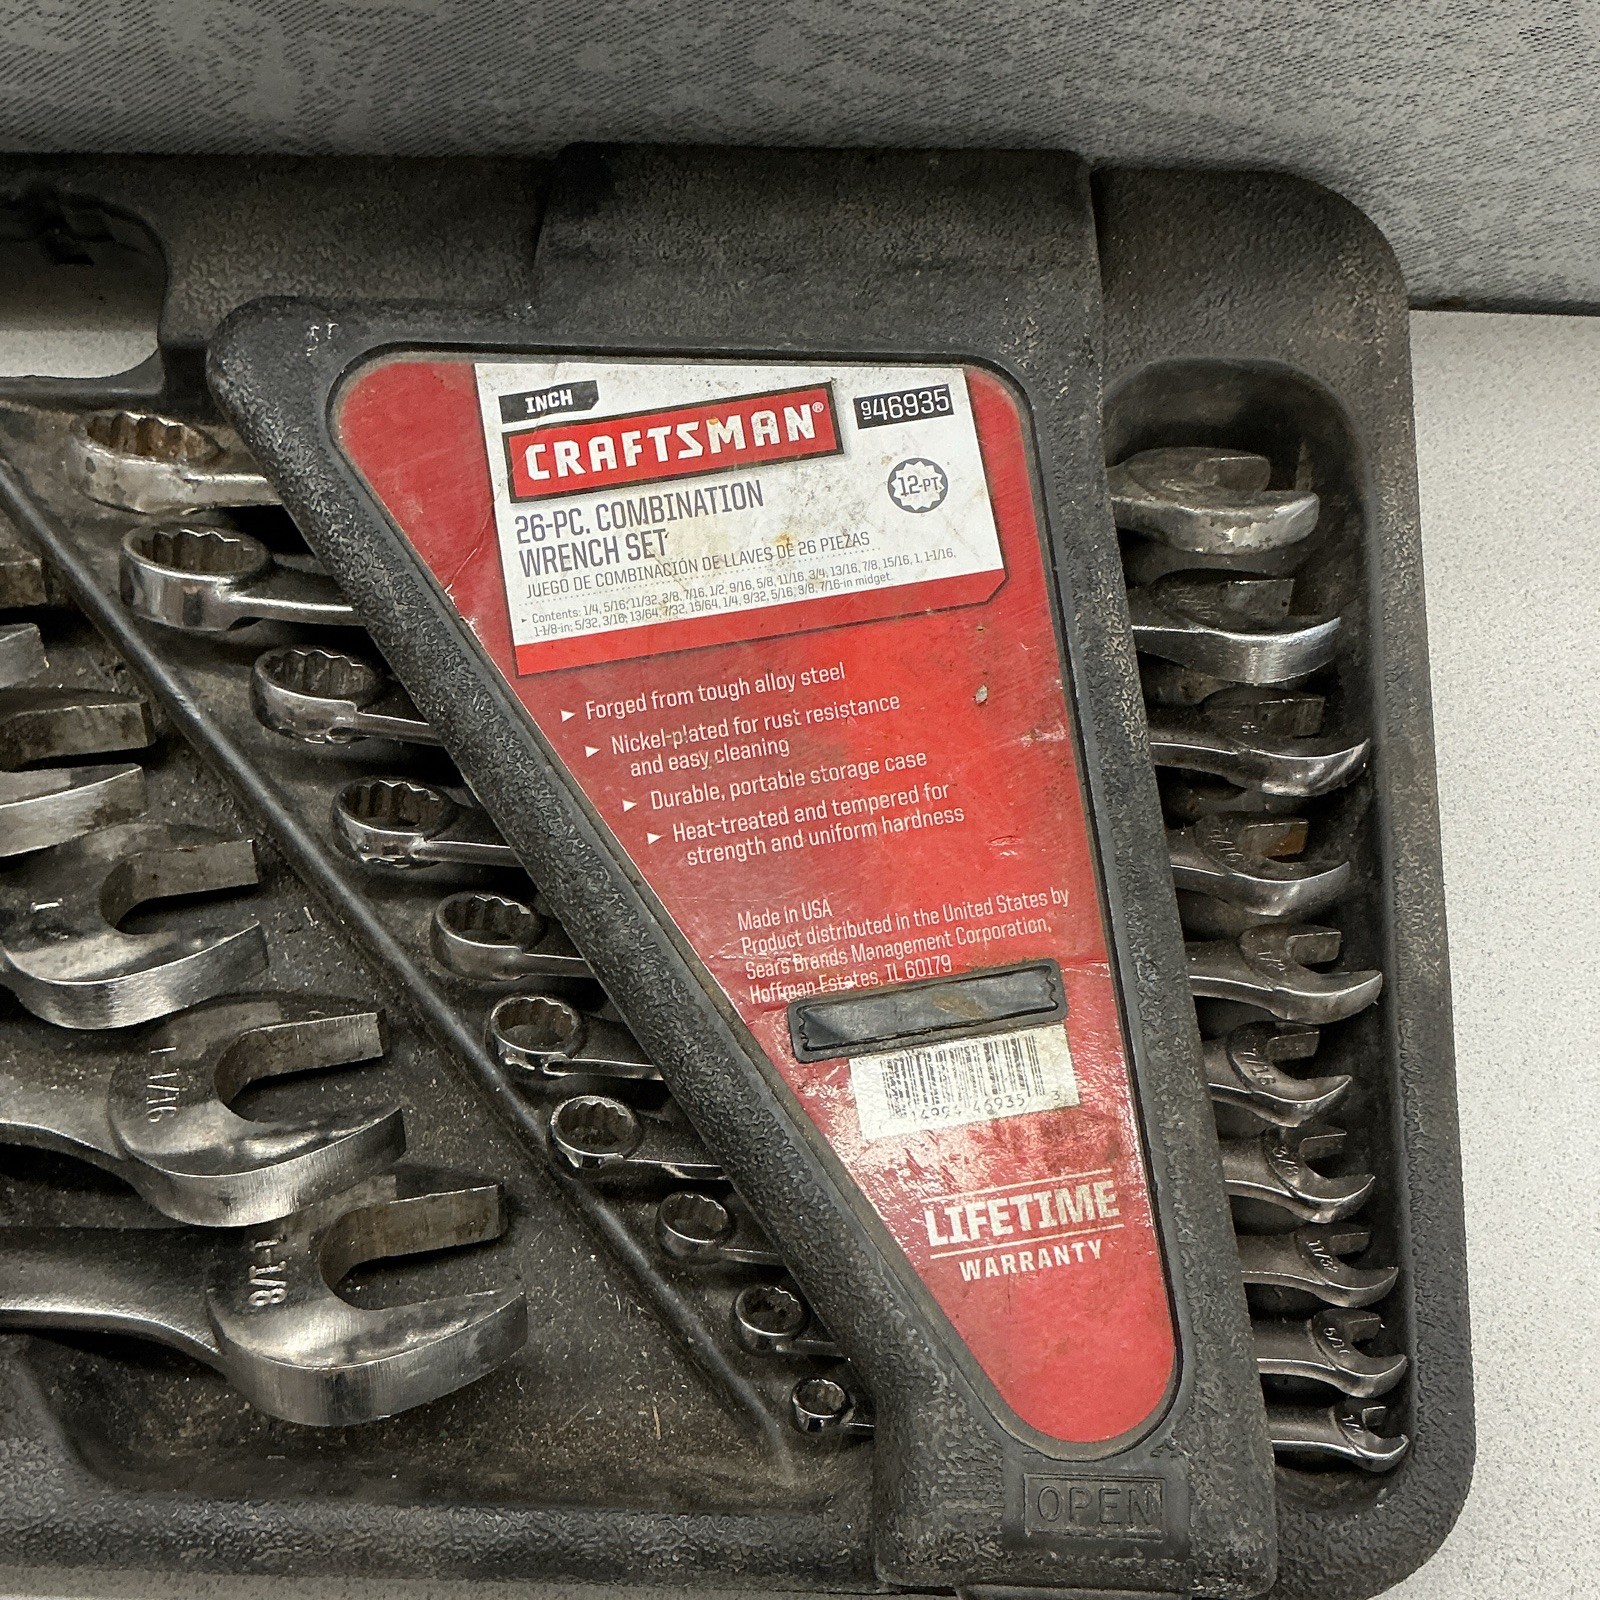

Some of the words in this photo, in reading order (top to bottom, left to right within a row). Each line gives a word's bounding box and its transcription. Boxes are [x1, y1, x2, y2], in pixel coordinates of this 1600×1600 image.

[524, 388, 574, 414] INCH
[514, 507, 591, 544] 26-PC.
[596, 480, 764, 532] COMBINATION
[519, 537, 620, 578] WRENCH
[625, 528, 668, 561] SET
[526, 579, 569, 599] JUEGO
[574, 575, 592, 591] DE
[595, 557, 698, 588] COMBINACIÓN
[702, 555, 721, 571] DE
[724, 546, 773, 568] LLAVES
[776, 543, 795, 559] DE
[798, 540, 817, 556] 26
[820, 531, 870, 552] PIEZAS
[532, 609, 581, 624] Contents:
[585, 694, 647, 721] Forged
[651, 689, 694, 709] from
[697, 677, 751, 704] tough
[755, 670, 796, 698] alloy
[800, 661, 846, 687] steel
[611, 722, 729, 755] Nickel-plated
[733, 715, 760, 735] for
[763, 708, 802, 729] rust
[805, 694, 901, 724] resistance
[630, 757, 664, 778] and
[668, 750, 710, 773] easy
[714, 736, 790, 765] cleaning
[650, 783, 726, 810] Durable,
[730, 770, 806, 801] portable
[810, 758, 881, 786] storage
[884, 750, 928, 773] case
[672, 810, 790, 843] Heat-treated
[793, 801, 828, 823] and
[831, 787, 920, 819] tempered
[923, 782, 950, 802] for
[686, 836, 767, 866] strength
[771, 829, 804, 852] and
[808, 818, 878, 848] uniform
[882, 806, 965, 834] hardness
[737, 909, 781, 931] Made
[784, 904, 799, 922] in
[801, 899, 833, 920] USA
[741, 931, 803, 956] Product
[806, 912, 892, 946] distributed
[896, 911, 911, 930] in
[913, 907, 940, 927] the
[943, 896, 992, 922] United
[995, 890, 1048, 914] States
[1050, 887, 1070, 908] by
[745, 957, 790, 981] Sears
[793, 948, 849, 973] Brands
[851, 930, 952, 964] Management
[955, 916, 1053, 946] Corporation,
[749, 975, 816, 1005] Hoffman
[818, 971, 884, 994] Estates,
[886, 962, 903, 983] IL
[904, 954, 952, 980] 60179
[923, 1179, 1120, 1248] LIFETIME
[958, 1238, 1103, 1282] WARRANTY
[1037, 1485, 1154, 1526] OPEN
